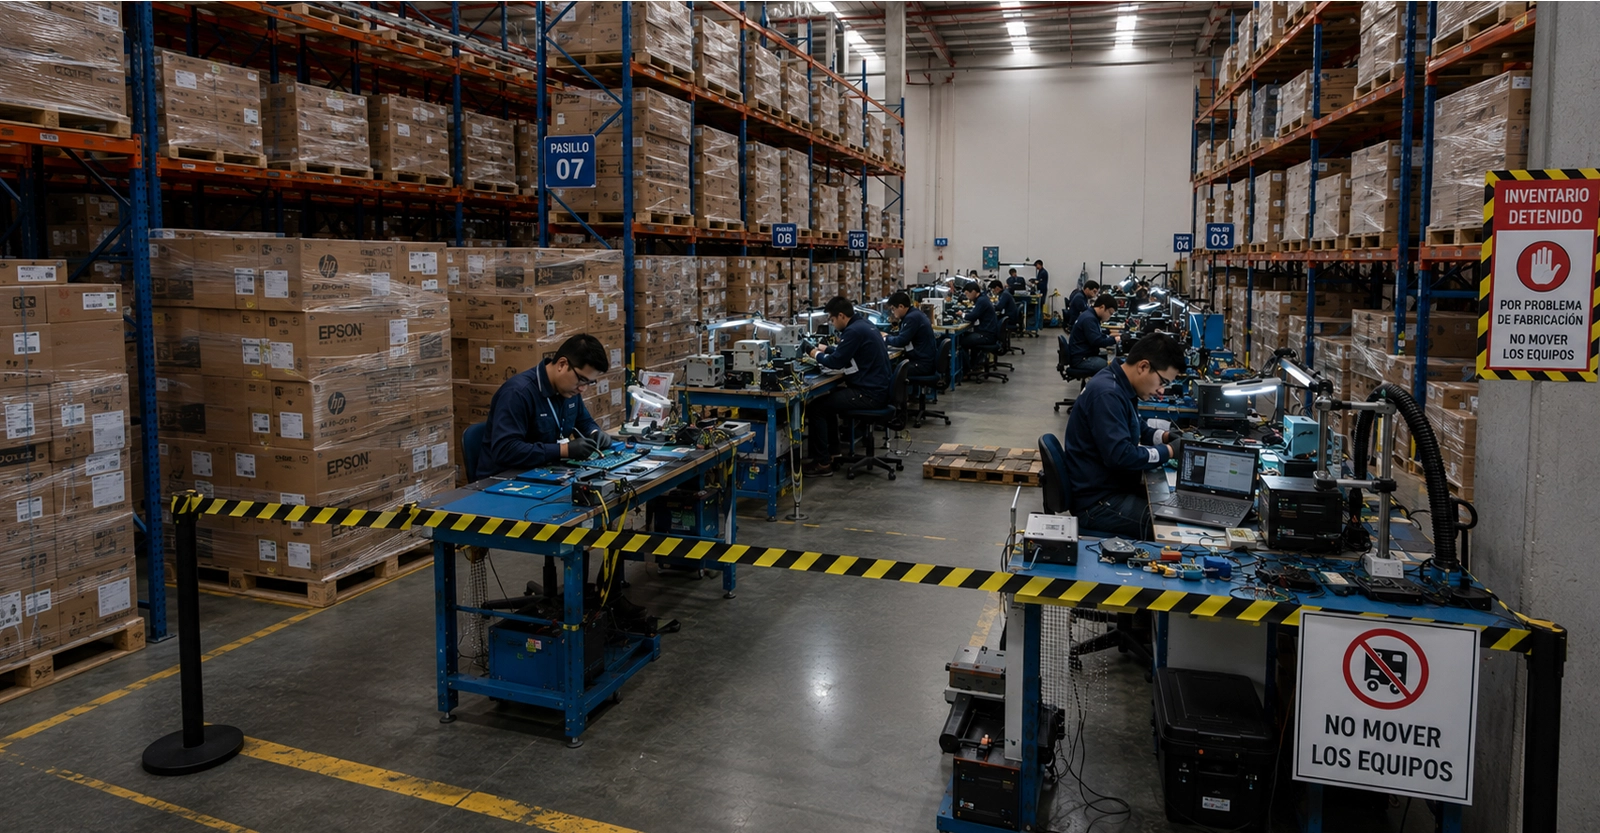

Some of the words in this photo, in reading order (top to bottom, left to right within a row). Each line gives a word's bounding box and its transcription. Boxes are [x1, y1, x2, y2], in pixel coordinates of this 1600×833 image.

[550, 141, 590, 154] PASILLO
[556, 158, 585, 180] 07
[1504, 187, 1590, 204] INVENTARIO
[1508, 208, 1583, 225] DETENIDO
[851, 238, 865, 248] 06
[1211, 233, 1229, 246] 03
[319, 254, 338, 278] hp
[1500, 300, 1522, 311] POR
[1524, 300, 1583, 311] PROBLEMA
[1497, 314, 1511, 325] DE
[318, 322, 362, 340] EPSON
[1509, 333, 1526, 345] NO
[1528, 334, 1568, 345] MOVER
[1502, 348, 1524, 360] LOS
[1526, 349, 1575, 361] EQUIPOS
[328, 391, 346, 415] hp
[326, 451, 370, 476] EPSON
[1325, 713, 1356, 737] NO
[1362, 718, 1441, 748] MOVER
[1311, 744, 1351, 768] LOS
[1357, 750, 1453, 782] EQUIPOS
